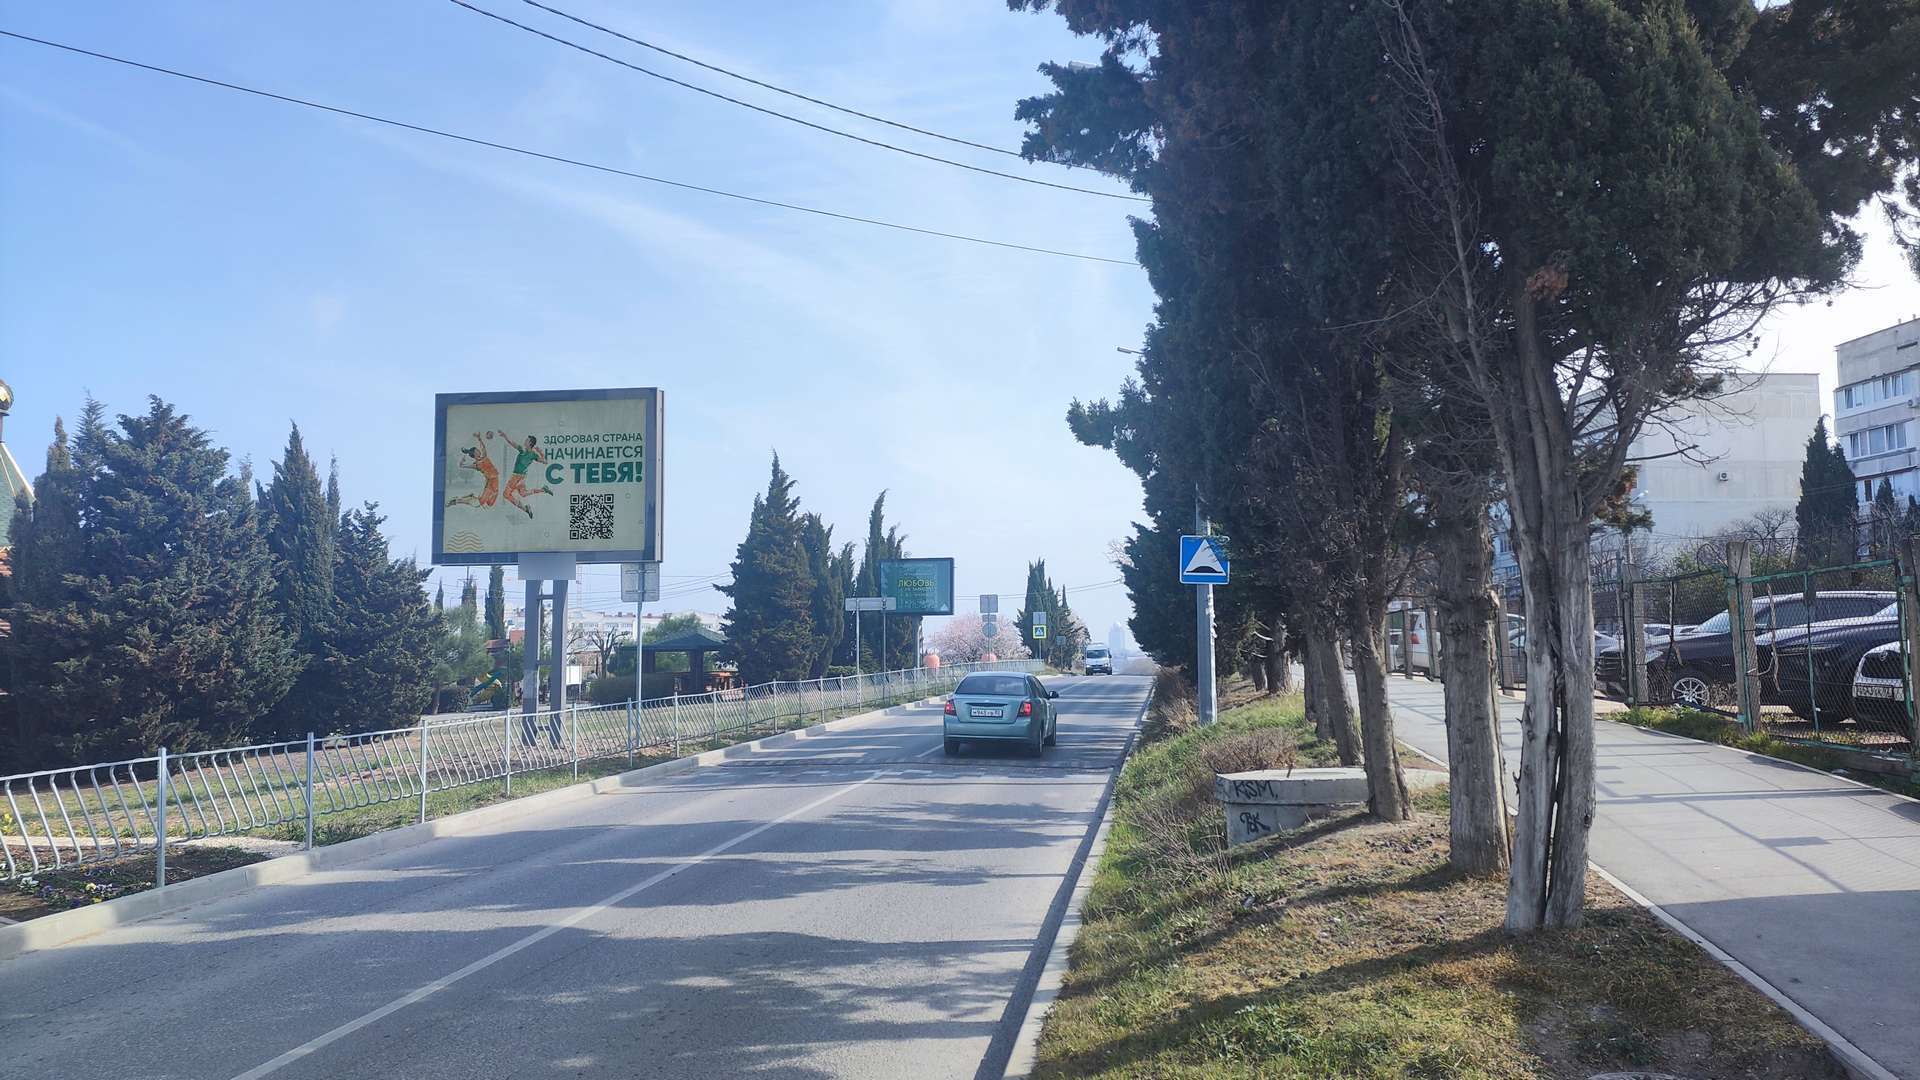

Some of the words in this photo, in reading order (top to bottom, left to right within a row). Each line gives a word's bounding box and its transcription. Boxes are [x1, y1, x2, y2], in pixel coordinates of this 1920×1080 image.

[544, 434, 599, 445] ЗДОРОВАЯ
[602, 432, 643, 443] СТРАНА
[544, 445, 643, 460] НАЧИНАЕТСЯ
[545, 464, 564, 485] С
[570, 461, 643, 484] ТЕБЯ!
[898, 579, 935, 587] ЛЮБОВЬ
